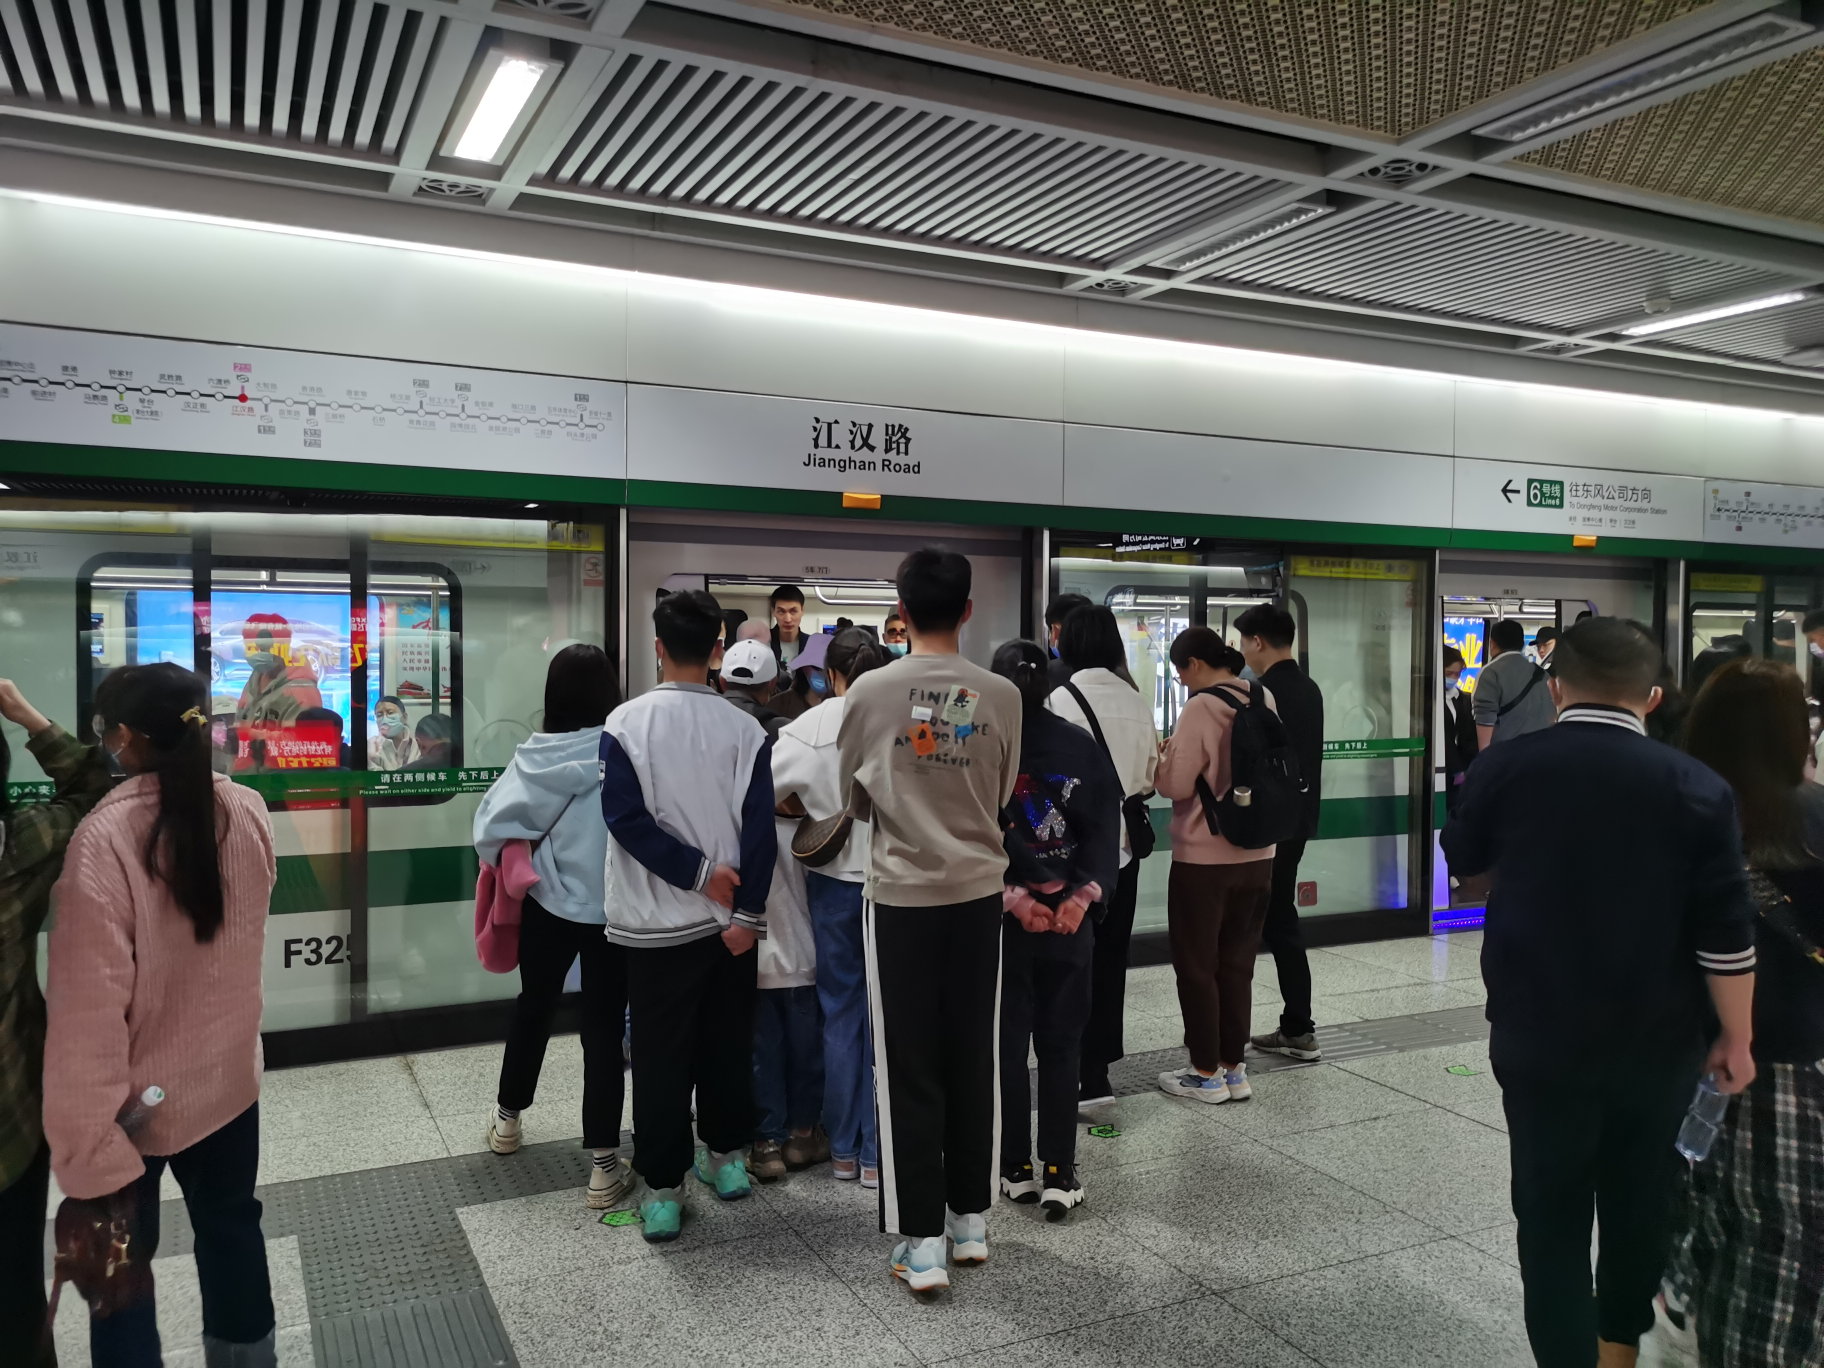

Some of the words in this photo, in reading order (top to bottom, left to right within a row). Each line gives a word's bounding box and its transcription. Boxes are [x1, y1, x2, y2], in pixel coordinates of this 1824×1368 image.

[811, 416, 912, 456] 江汉路
[803, 453, 876, 473] Jianghan
[882, 458, 921, 475] Road
[1568, 481, 1652, 504] 往东风公司方向
[1569, 501, 1576, 509] To
[1576, 502, 1602, 512] Dongfeng
[1603, 504, 1618, 512] Motor
[1619, 505, 1649, 514] Corporation
[1649, 507, 1668, 515] Station
[817, 566, 828, 575] 7门
[381, 771, 447, 784] 请在两侧候车
[458, 770, 500, 781] 先下后上
[284, 934, 351, 969] F32
